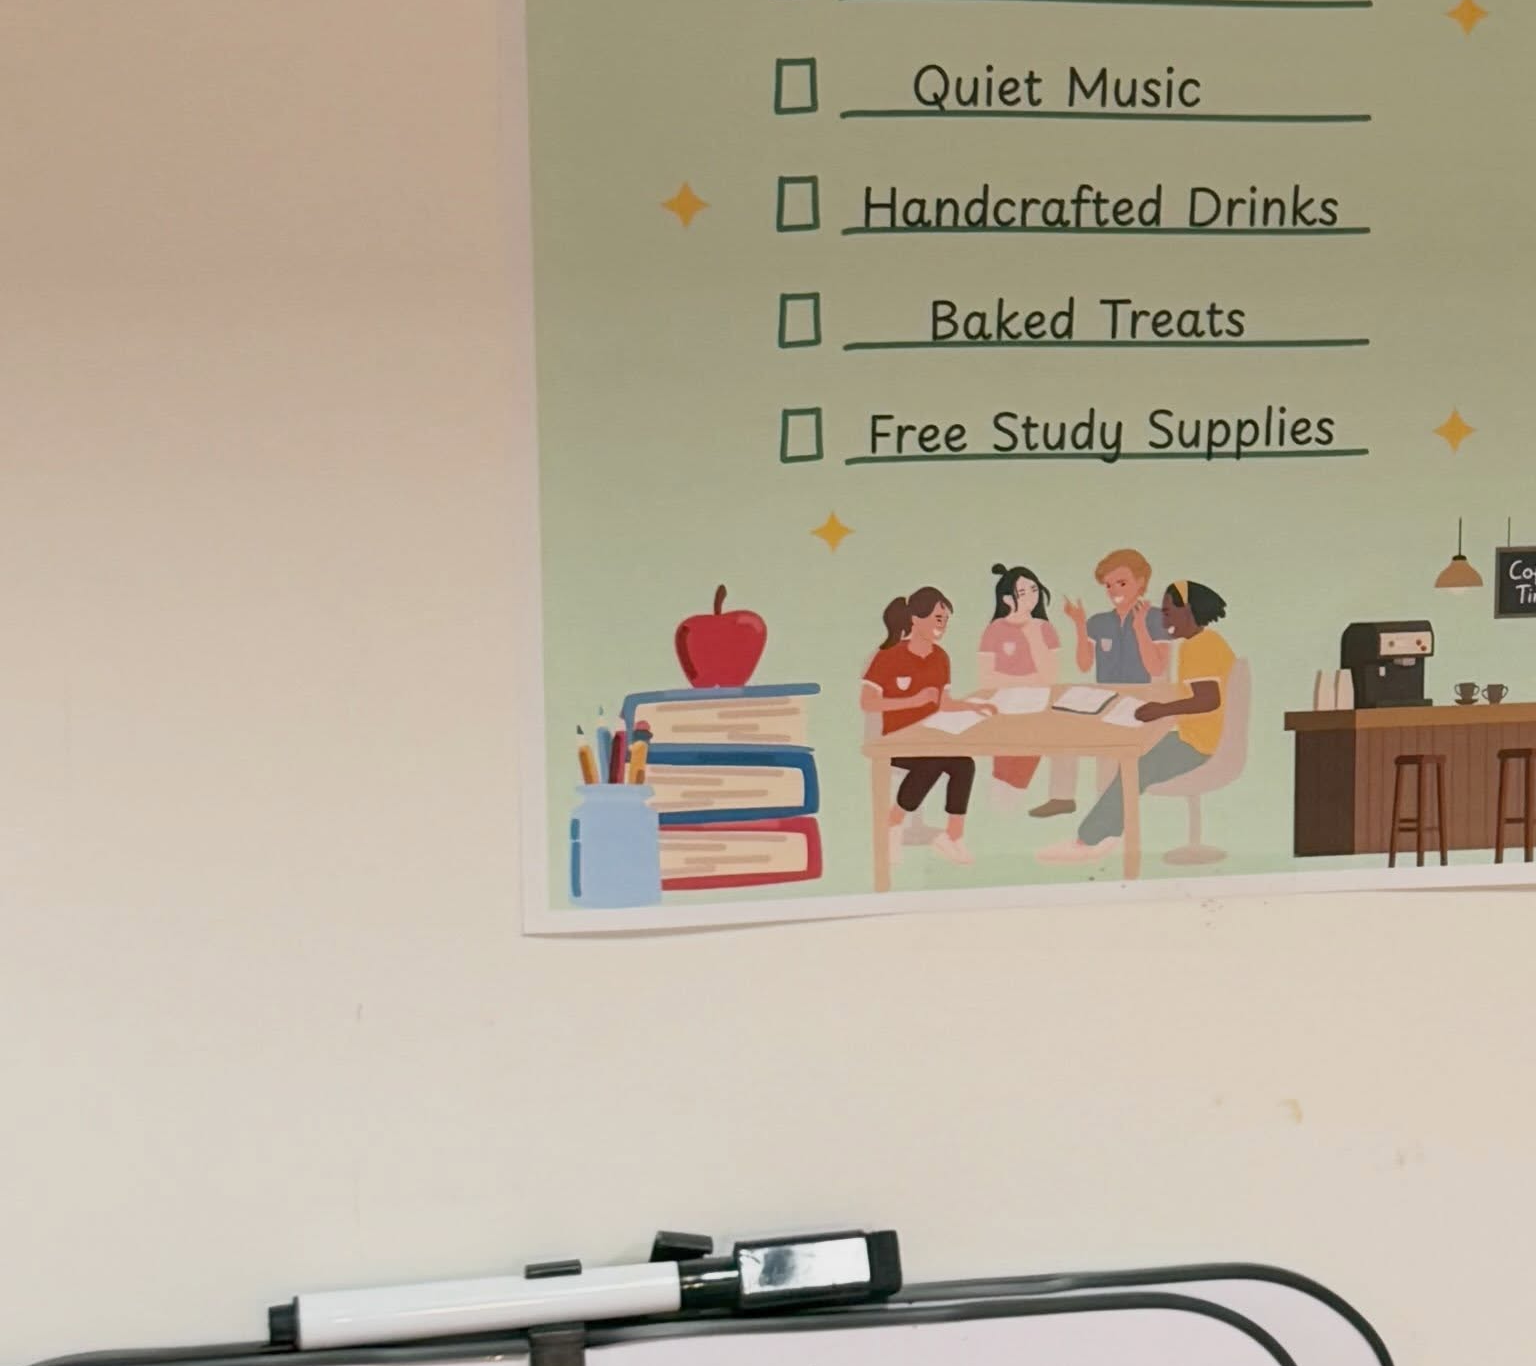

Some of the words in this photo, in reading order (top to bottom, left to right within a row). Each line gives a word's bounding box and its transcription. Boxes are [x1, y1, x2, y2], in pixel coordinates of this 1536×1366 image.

[913, 63, 1043, 112] Quiet
[1067, 66, 1202, 108] Music
[862, 183, 1163, 229] Handcrafted
[1188, 184, 1340, 228] Drinks
[931, 296, 1075, 341] Baked
[1100, 298, 1246, 339] Treats
[870, 413, 968, 454] Free
[992, 407, 1124, 464] Study
[1148, 405, 1335, 460] Supplies
